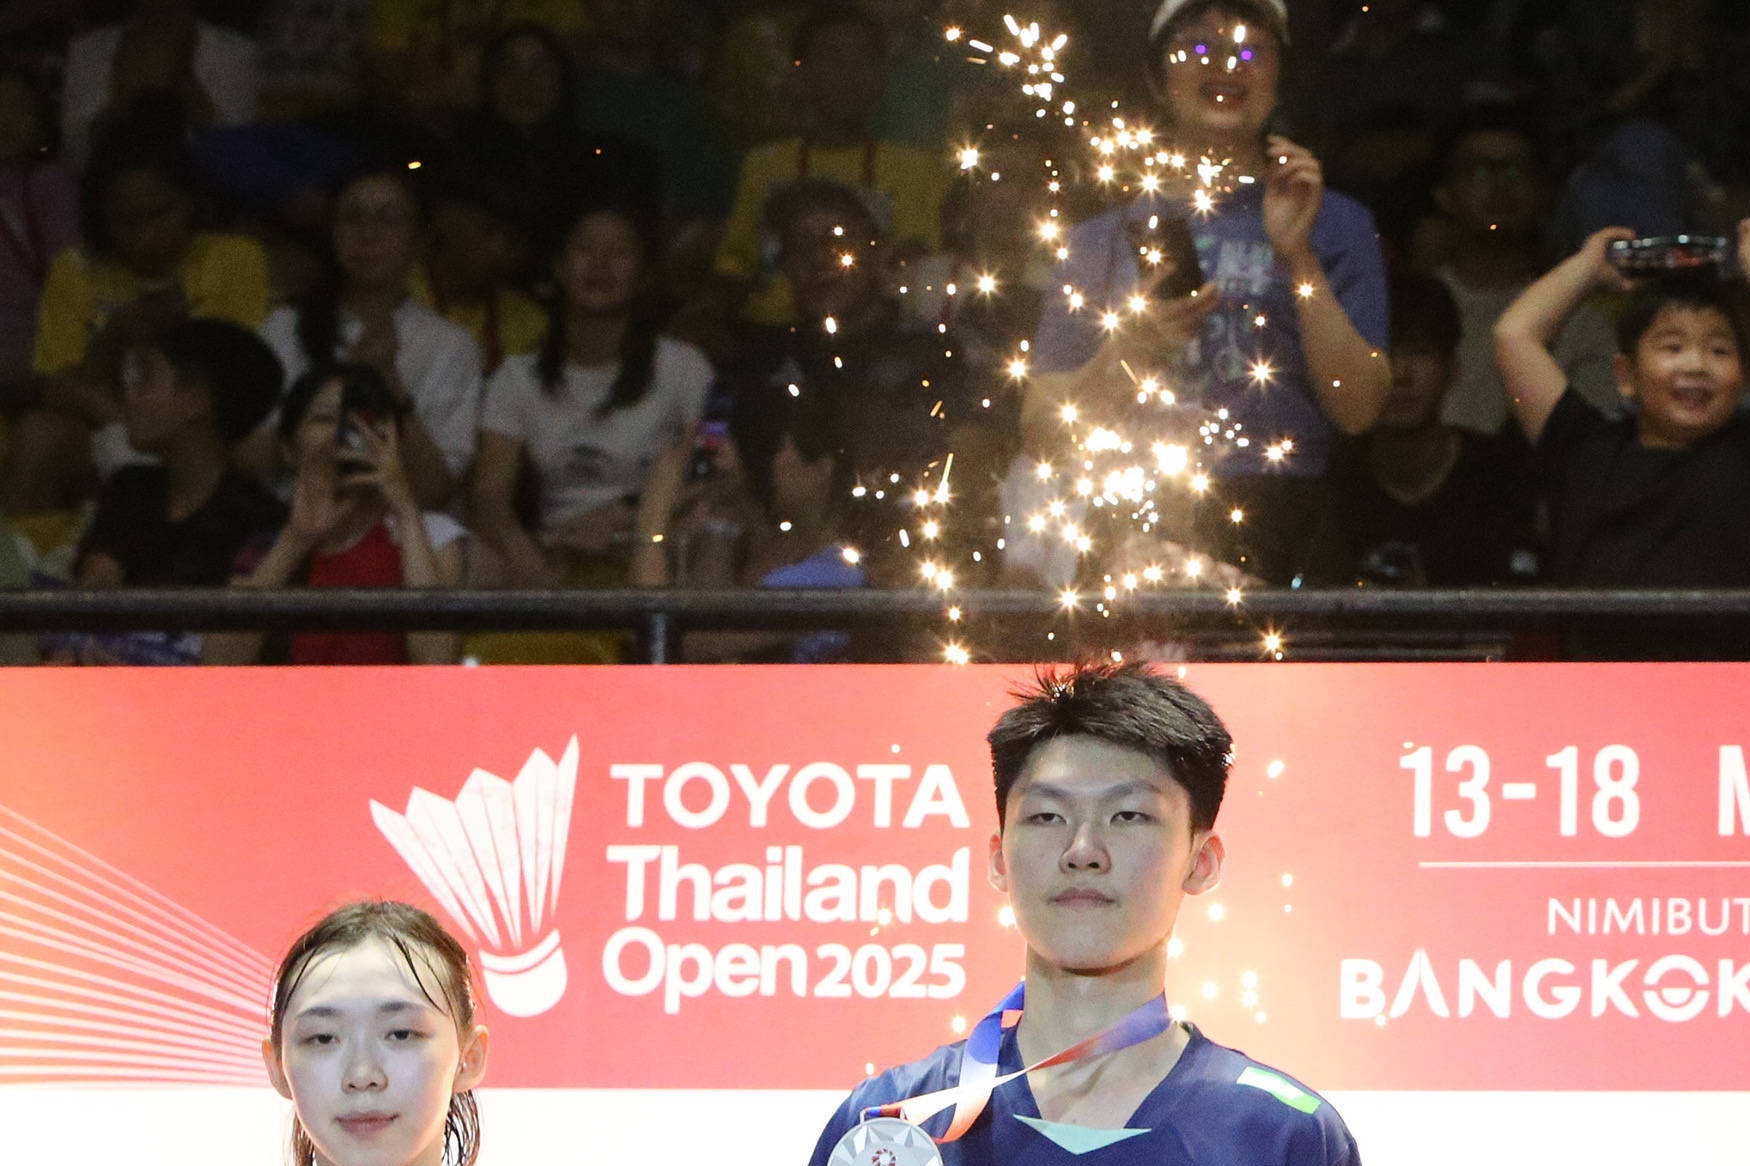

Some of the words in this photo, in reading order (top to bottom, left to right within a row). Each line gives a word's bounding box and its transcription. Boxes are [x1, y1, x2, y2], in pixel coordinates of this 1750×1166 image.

[609, 761, 971, 829] TOYOTA
[1400, 744, 1641, 837] 13-18
[606, 845, 970, 922] Thailand
[602, 926, 805, 1014] Open
[814, 944, 965, 999] 2025
